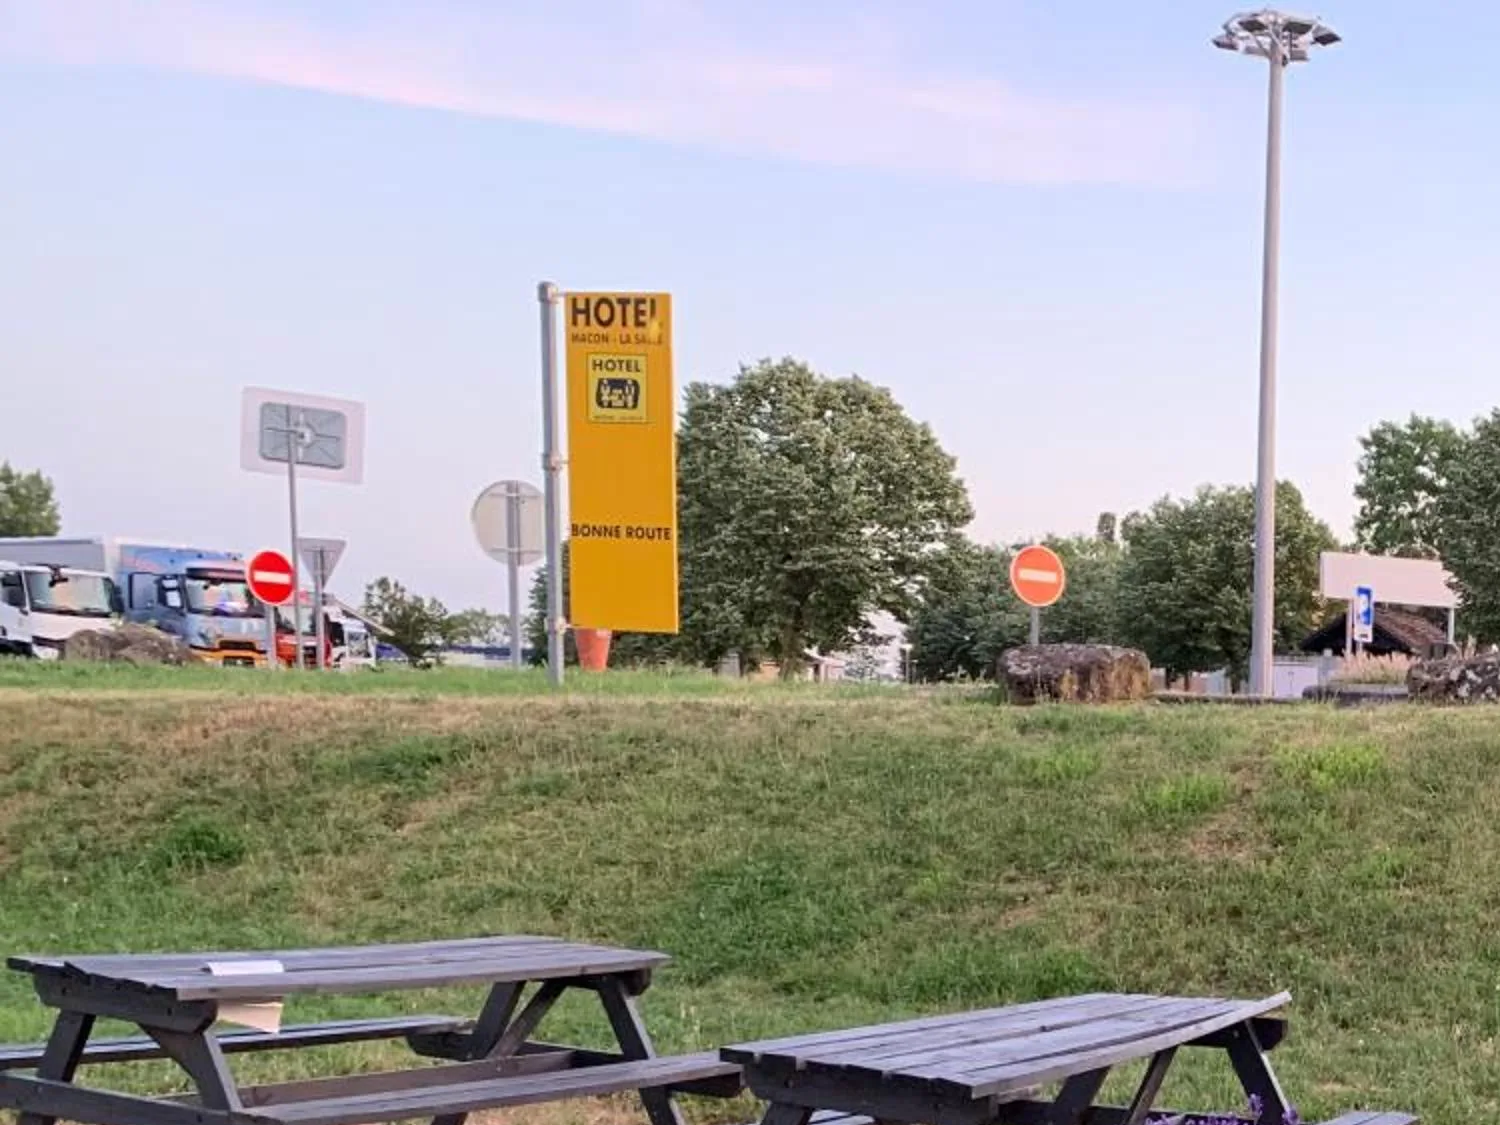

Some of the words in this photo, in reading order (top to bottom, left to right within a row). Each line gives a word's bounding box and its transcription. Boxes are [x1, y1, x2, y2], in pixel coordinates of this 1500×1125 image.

[635, 332, 663, 345] SAE
[592, 359, 641, 373] HOTEL
[571, 523, 621, 538] BONNE
[626, 525, 672, 541] ROUTE
